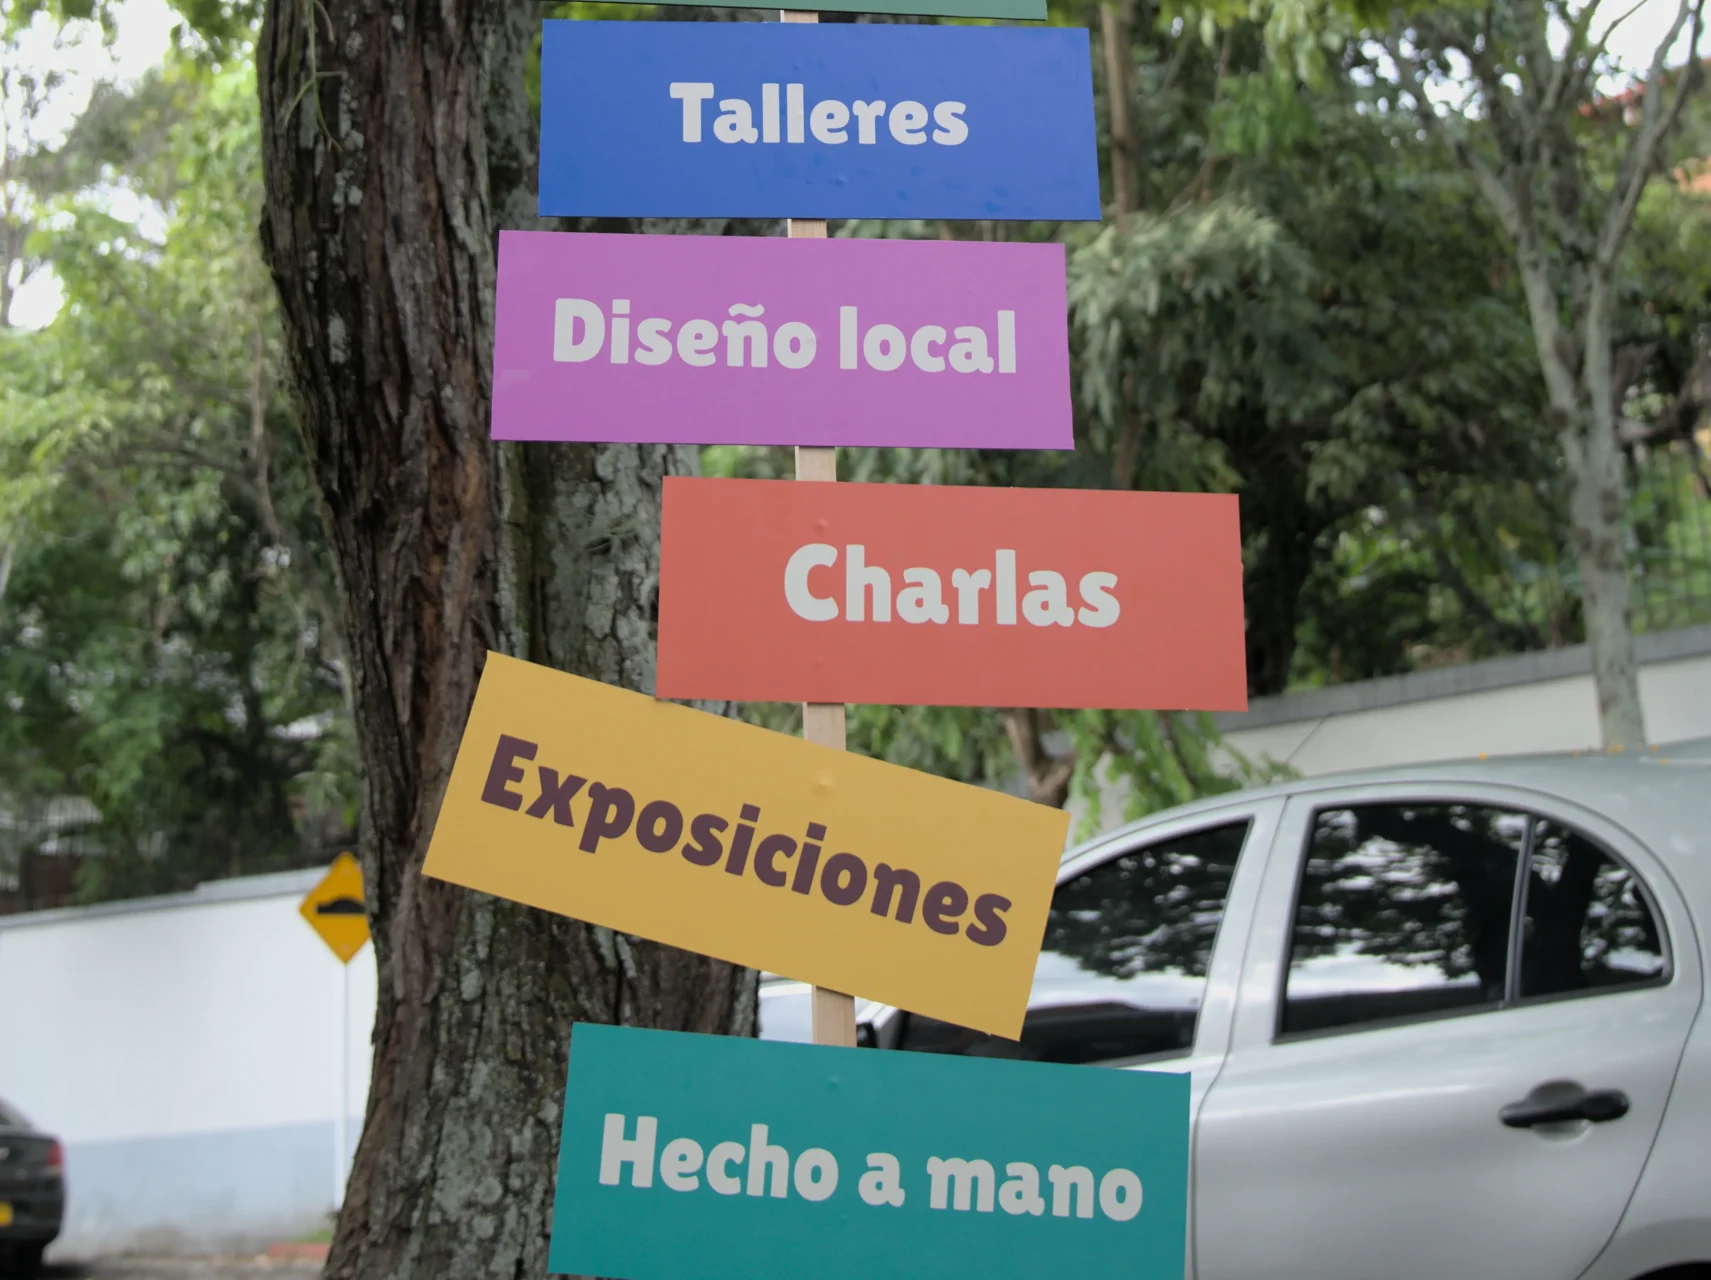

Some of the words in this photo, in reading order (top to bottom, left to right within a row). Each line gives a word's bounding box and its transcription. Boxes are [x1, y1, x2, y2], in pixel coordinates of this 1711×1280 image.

[669, 82, 969, 146] Talleres
[553, 297, 817, 369] Diseño
[839, 305, 1017, 374] local
[784, 543, 1121, 628] Charlas
[480, 733, 1013, 947] Exposiciones
[598, 1113, 839, 1202] Hecho
[858, 1152, 906, 1207] a
[926, 1156, 1143, 1222] mano
